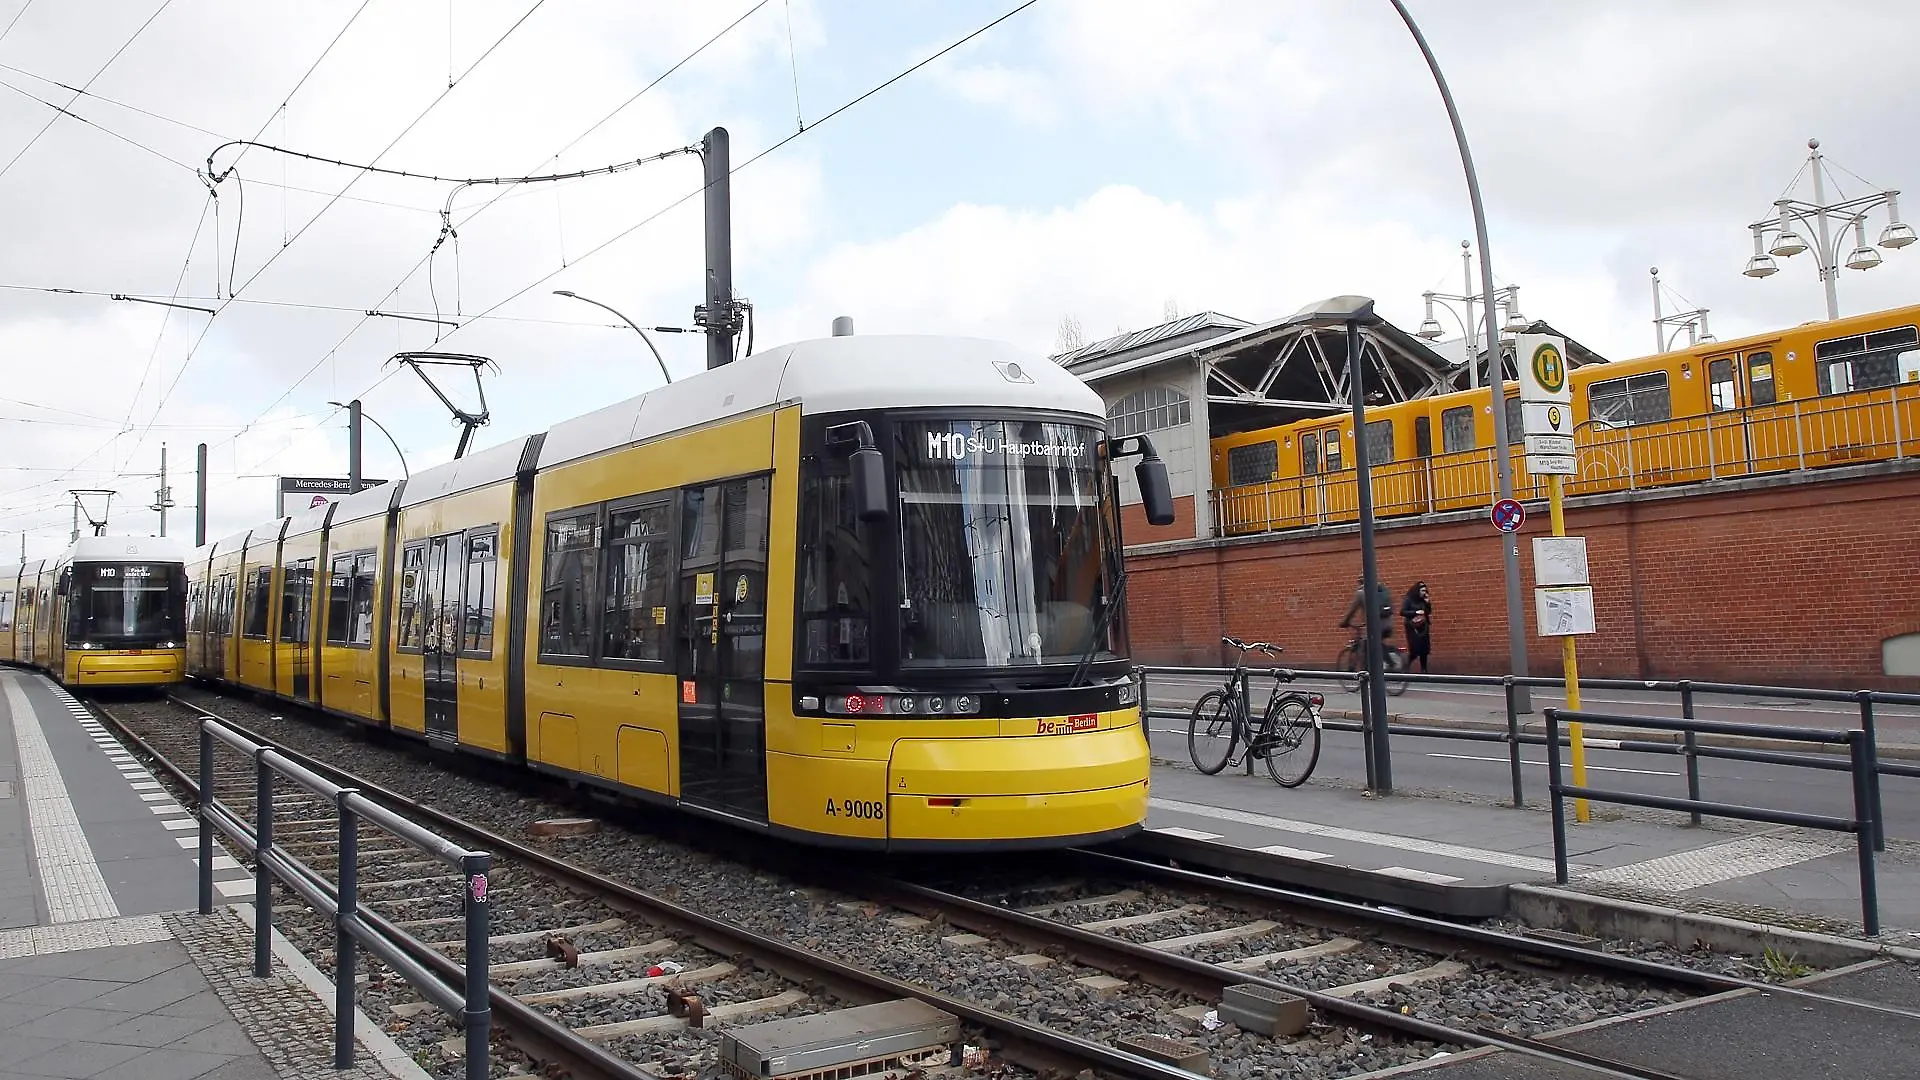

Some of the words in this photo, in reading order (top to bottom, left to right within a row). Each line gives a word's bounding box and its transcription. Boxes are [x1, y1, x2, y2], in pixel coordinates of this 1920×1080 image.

[1542, 354, 1559, 381] H
[1552, 411, 1558, 421] 5
[927, 431, 966, 460] M10
[966, 437, 995, 454] S+U
[998, 438, 1085, 458] Hauptbahnhof
[100, 567, 116, 577] M10
[1037, 718, 1055, 734] be
[1074, 717, 1096, 728] Berlin
[825, 798, 884, 820] A-9008
